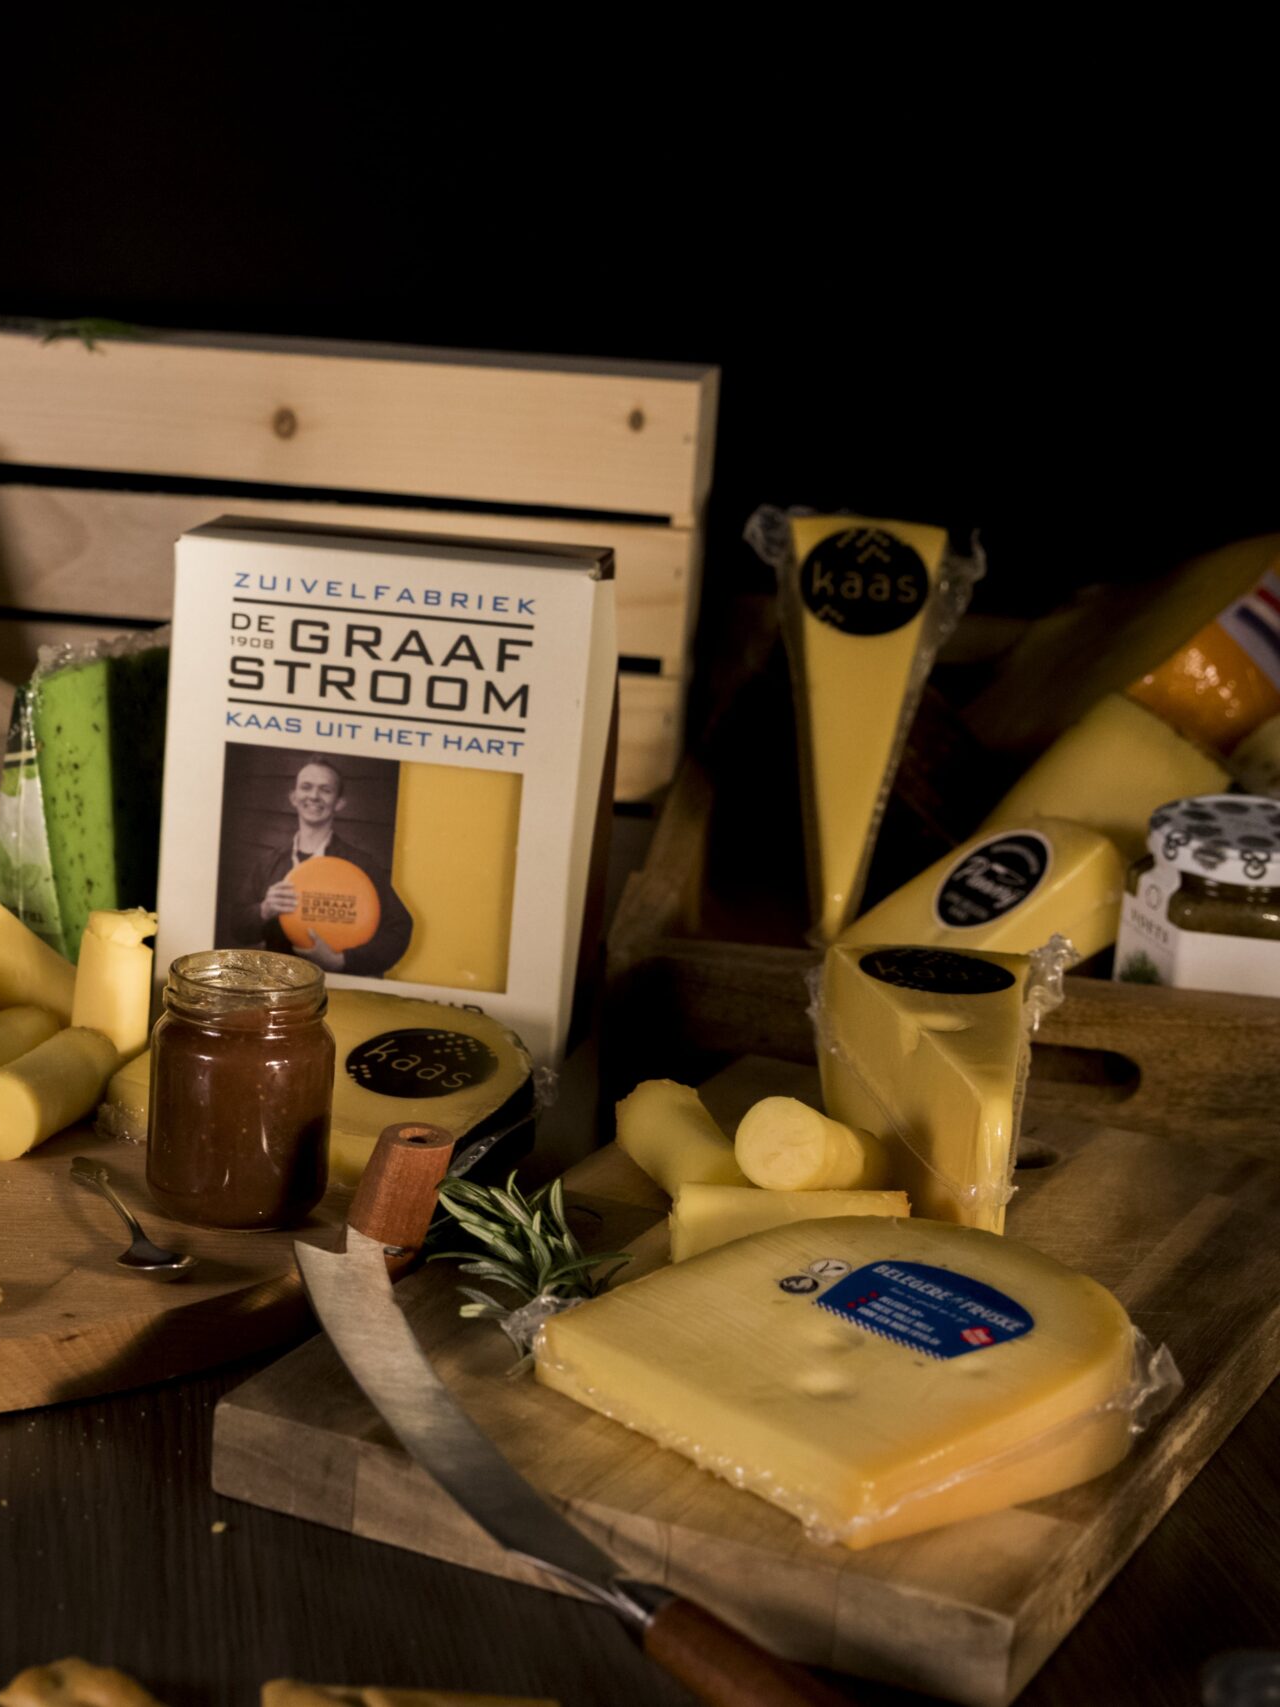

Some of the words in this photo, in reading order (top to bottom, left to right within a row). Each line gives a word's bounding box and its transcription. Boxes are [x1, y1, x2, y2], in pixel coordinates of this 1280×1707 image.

[233, 572, 536, 616] ZUIVELFABRIEK
[812, 560, 919, 604] kaas
[230, 635, 275, 650] 1908
[231, 612, 276, 633] DE
[290, 618, 533, 673] GRAAF
[228, 656, 530, 718] STROOM
[226, 711, 302, 734] KAAS
[316, 720, 362, 740] UIT
[373, 727, 432, 748] HET
[443, 734, 525, 757] HART
[364, 1039, 472, 1089] kaas
[871, 1264, 954, 1300] BELEGERE
